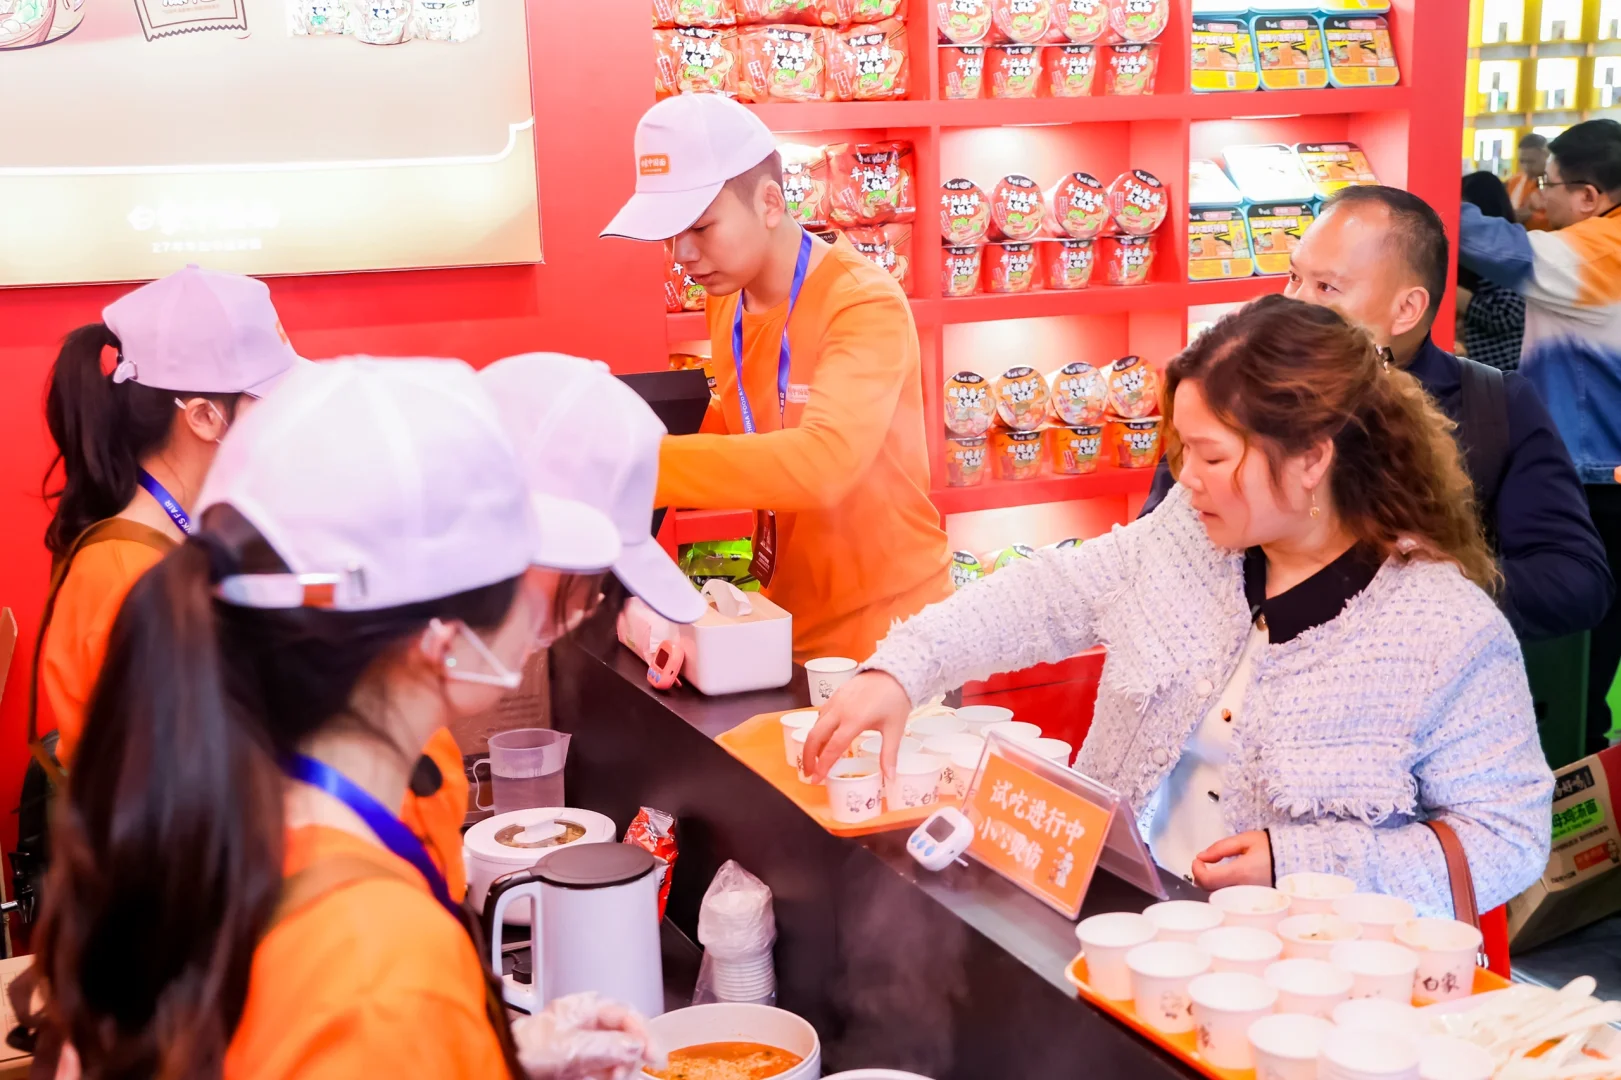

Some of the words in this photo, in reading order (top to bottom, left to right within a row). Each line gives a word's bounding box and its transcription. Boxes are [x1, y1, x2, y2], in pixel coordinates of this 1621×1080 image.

[164, 499, 182, 519] FAIR
[990, 779, 1086, 847] 试吃进行中
